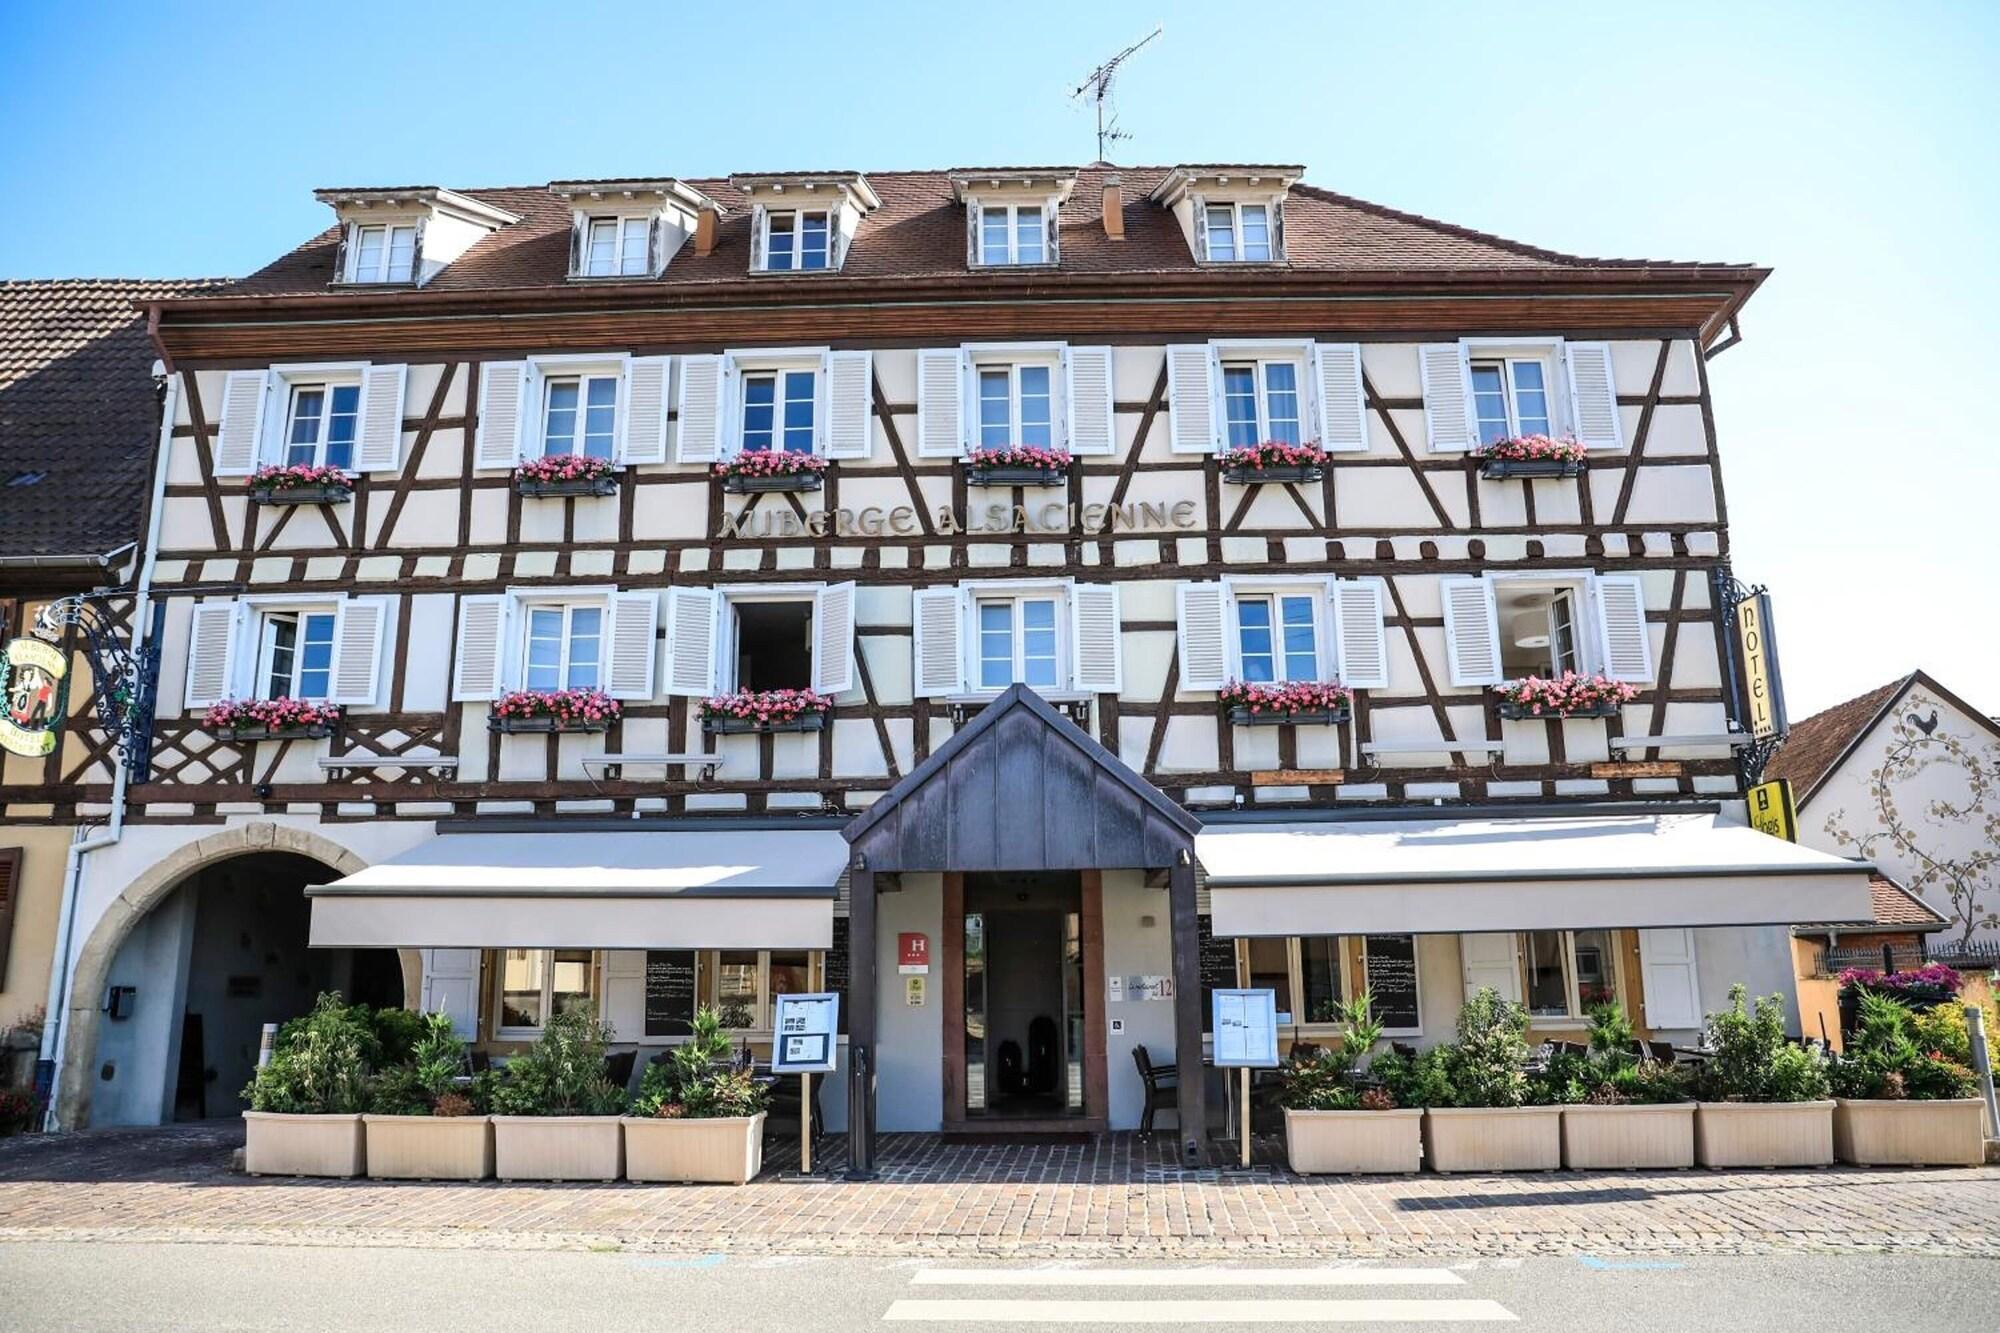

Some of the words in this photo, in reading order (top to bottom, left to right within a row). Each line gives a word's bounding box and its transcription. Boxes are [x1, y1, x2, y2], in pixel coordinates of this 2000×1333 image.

[716, 505, 914, 539] AUBERGE
[933, 499, 1197, 533] ALSACIENNE
[911, 939, 925, 952] H
[1160, 978, 1173, 997] 12
